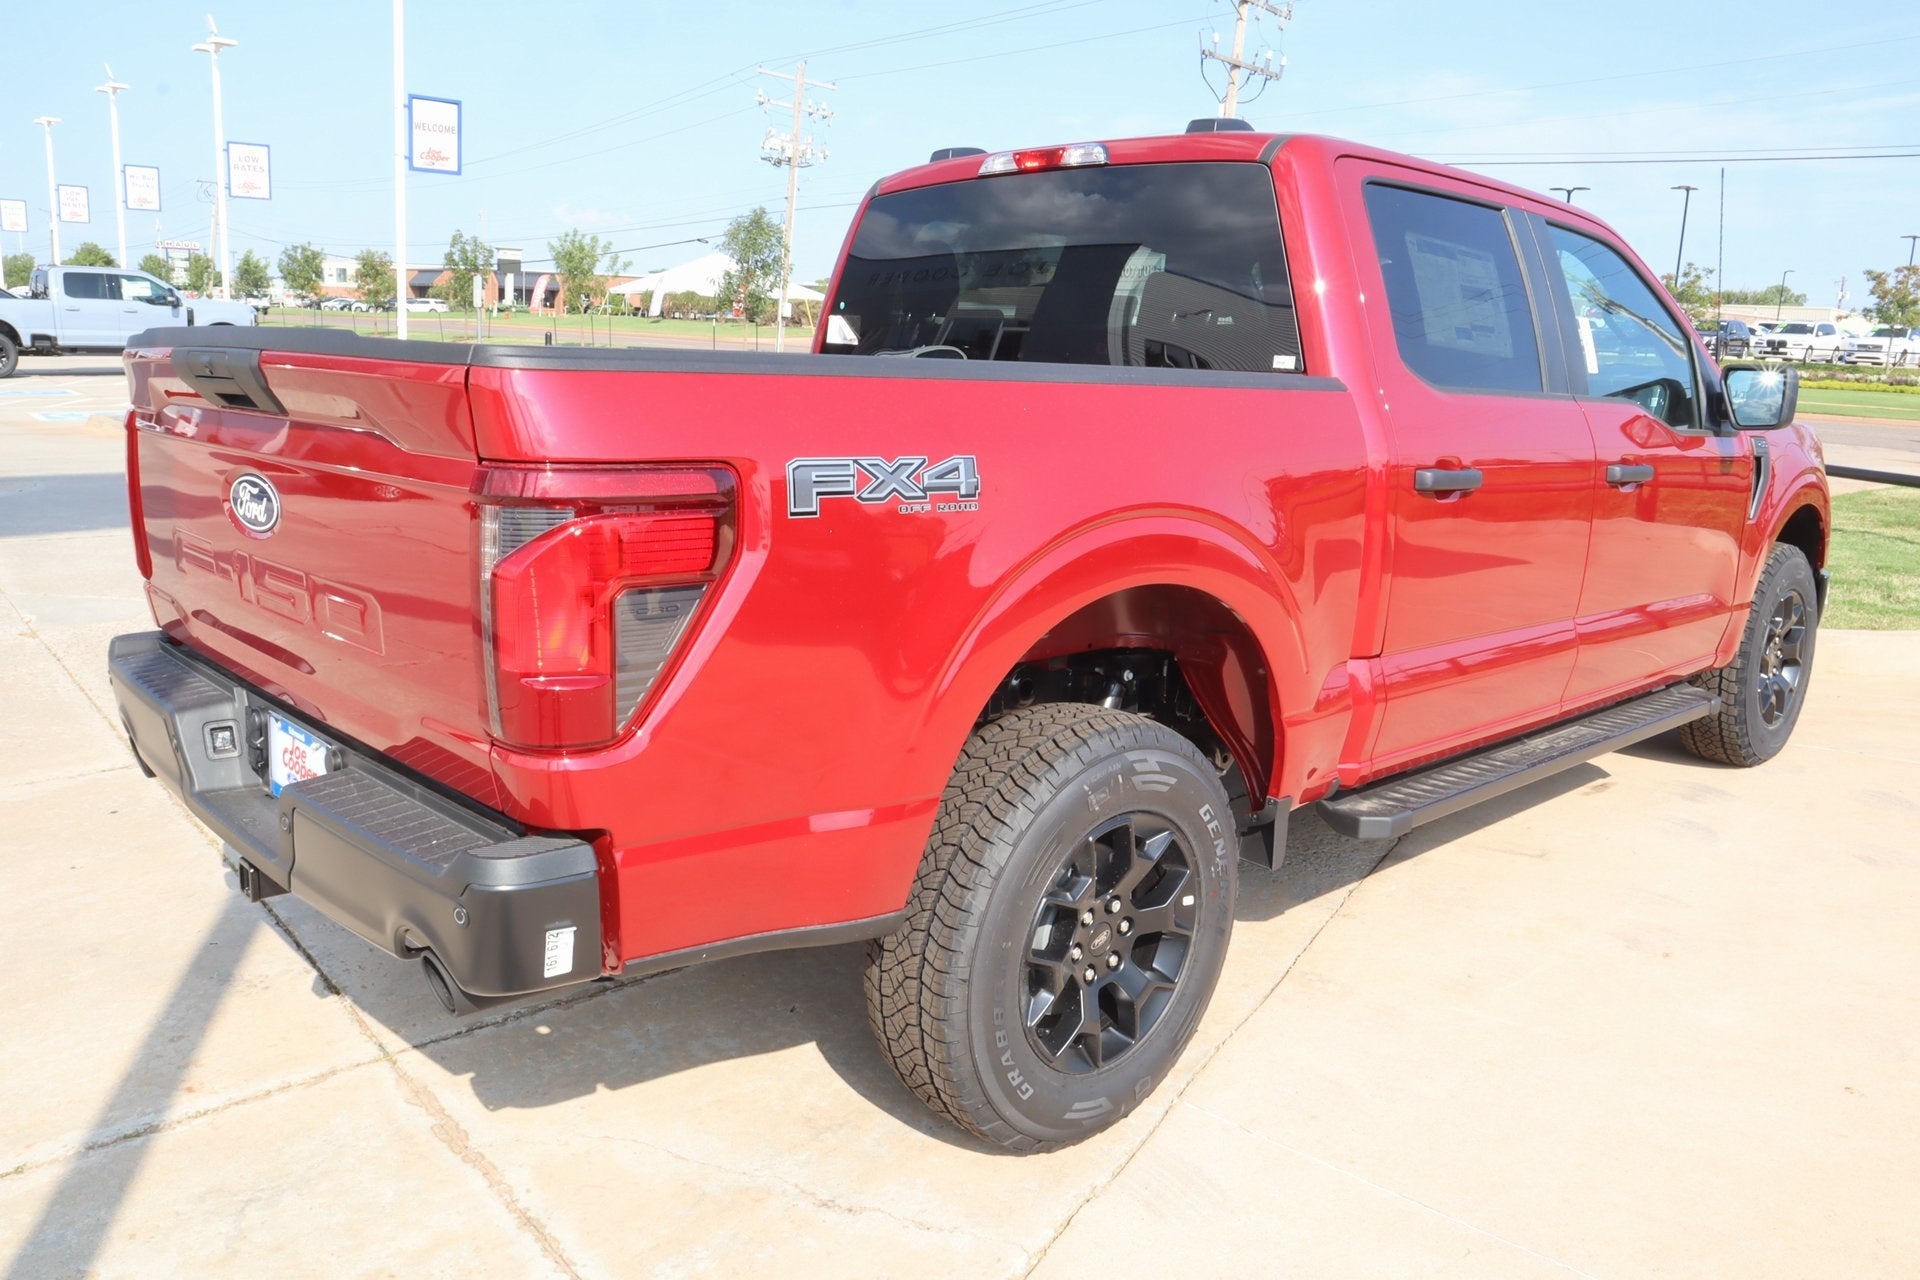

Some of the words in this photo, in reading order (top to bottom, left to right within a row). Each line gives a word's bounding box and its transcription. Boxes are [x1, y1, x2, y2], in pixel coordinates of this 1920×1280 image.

[414, 121, 456, 135] WELCOME
[238, 154, 260, 164] LOW
[419, 151, 450, 162] Cooper
[233, 163, 265, 174] RATES
[786, 455, 980, 519] FX4
[898, 503, 932, 515] OFF
[936, 501, 979, 513] ROAD
[620, 603, 681, 617] FORD
[289, 737, 308, 764] Joe
[282, 746, 318, 780] Cooper
